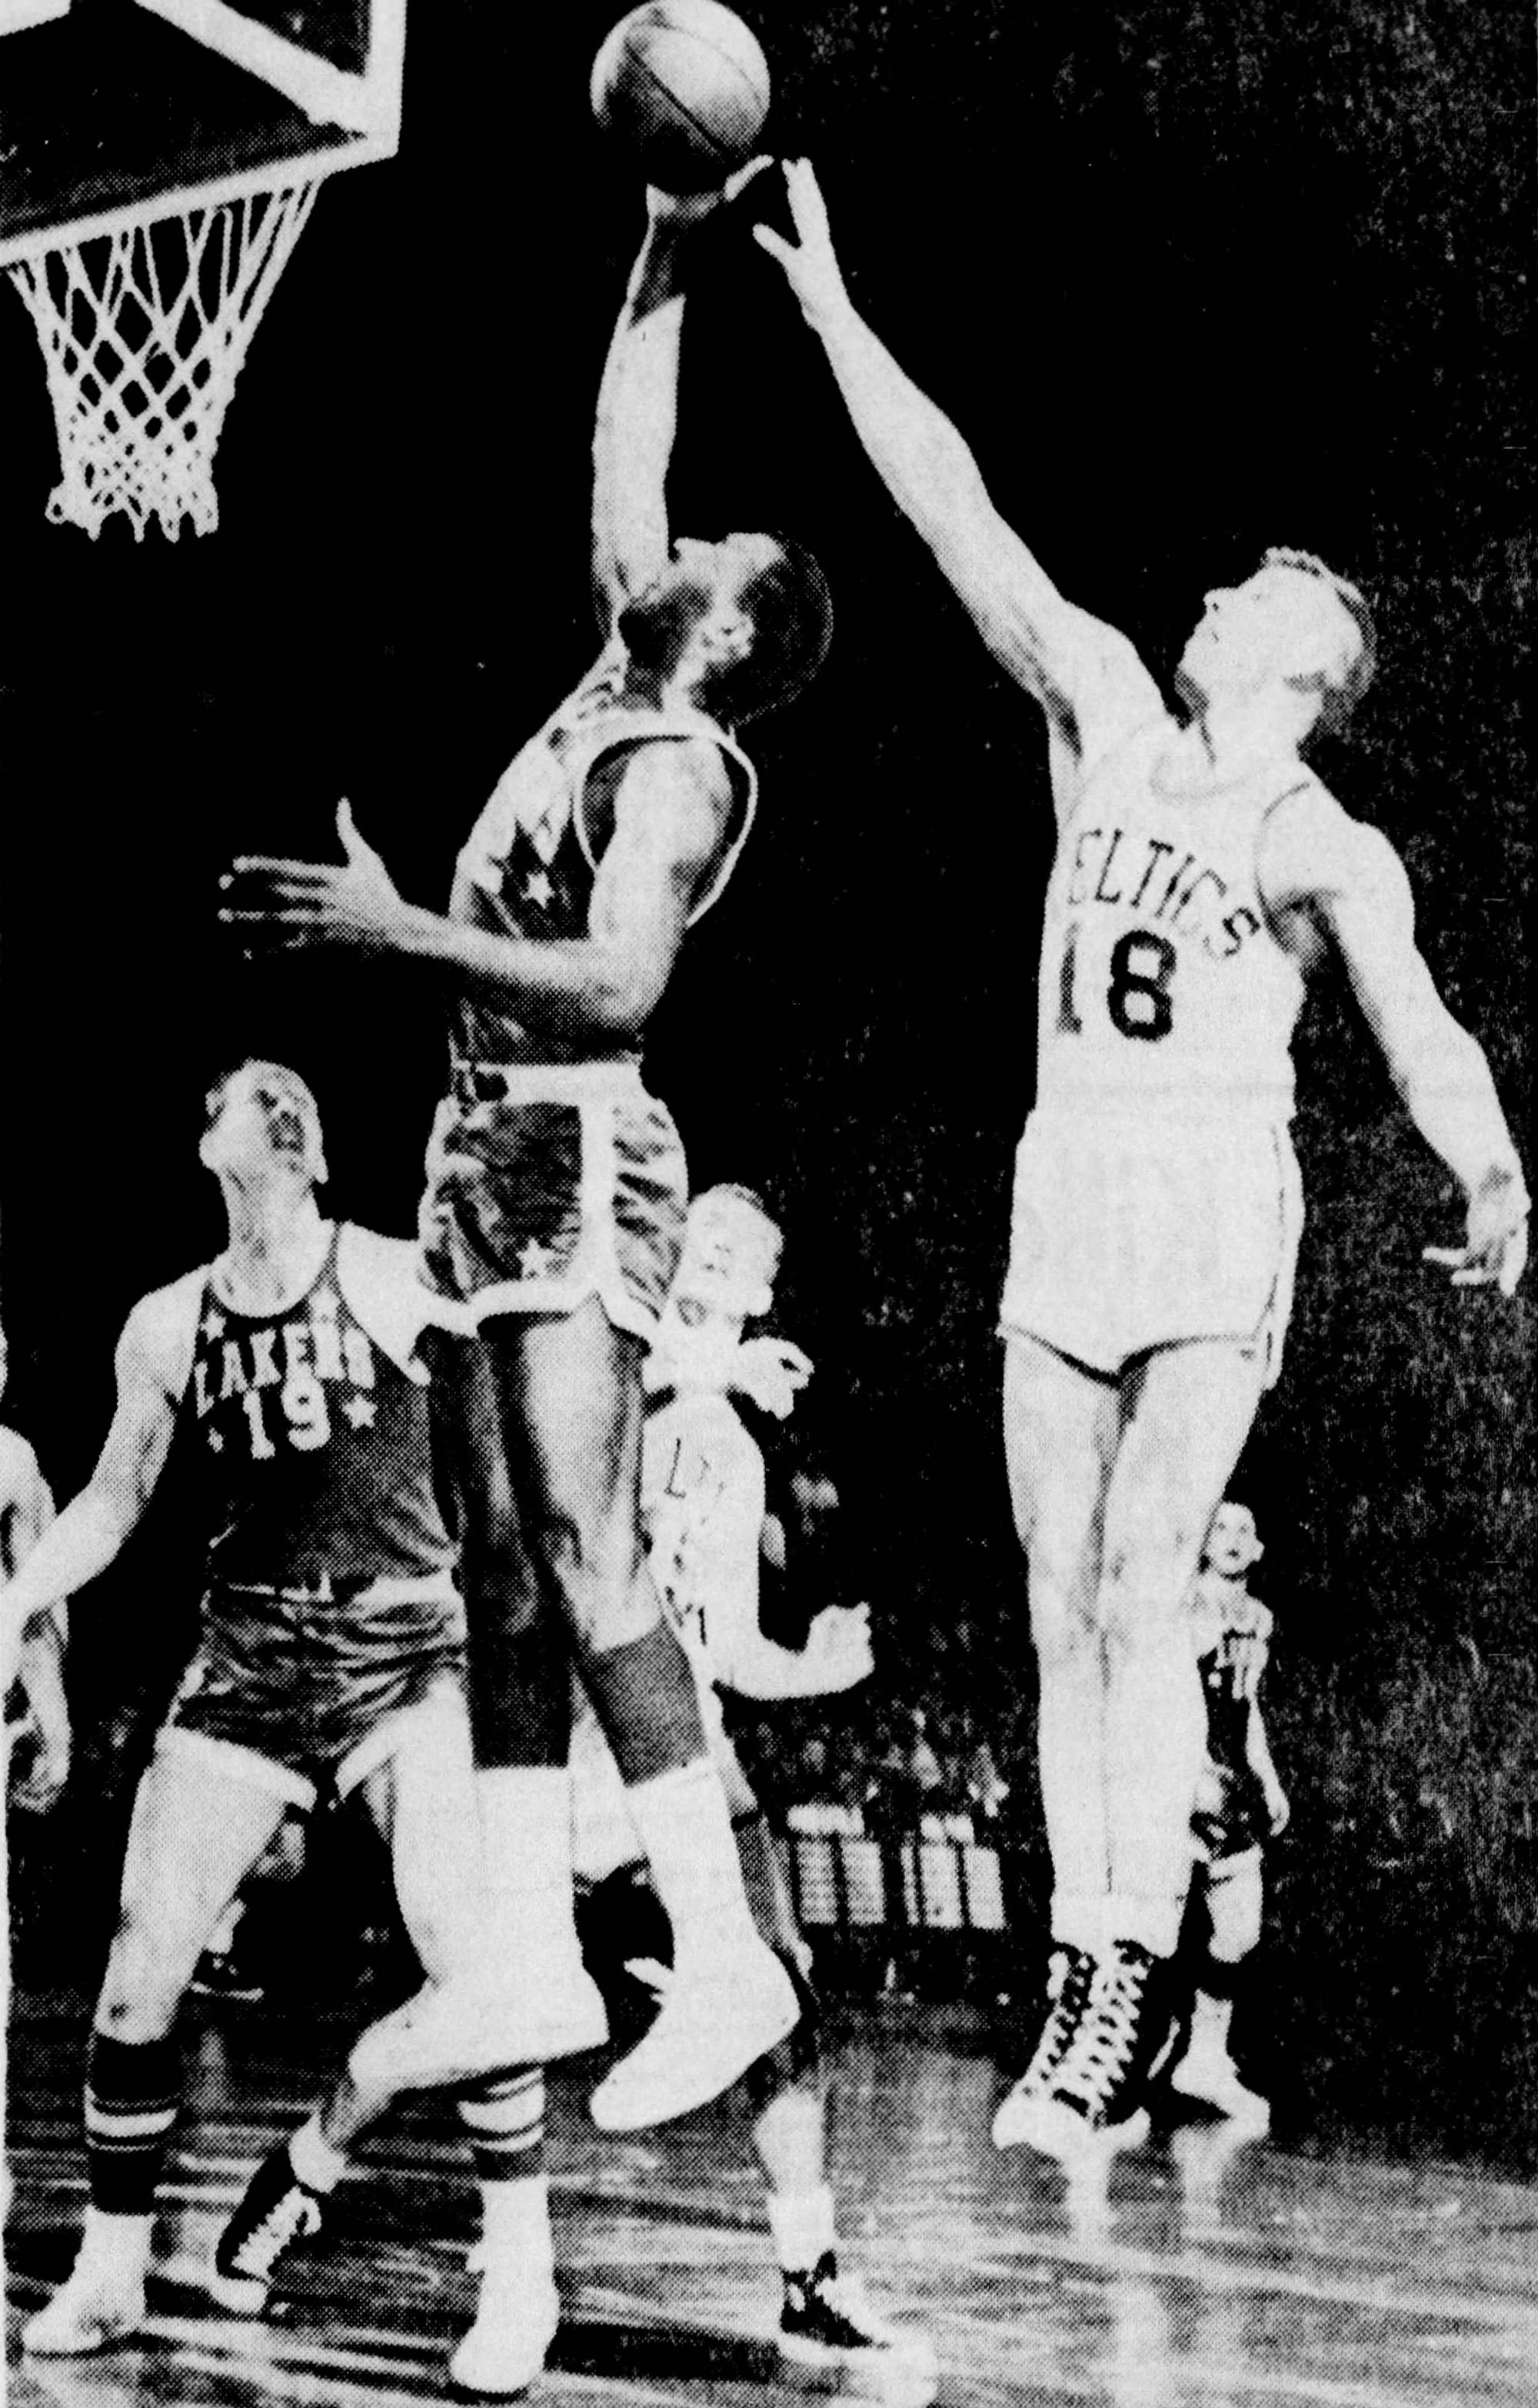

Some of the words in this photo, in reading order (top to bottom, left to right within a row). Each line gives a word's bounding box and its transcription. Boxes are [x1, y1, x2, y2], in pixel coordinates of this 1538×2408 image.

[1067, 827, 1260, 959] ELTICS
[1057, 922, 1177, 1043] 18
[242, 1385, 331, 1460] 19
